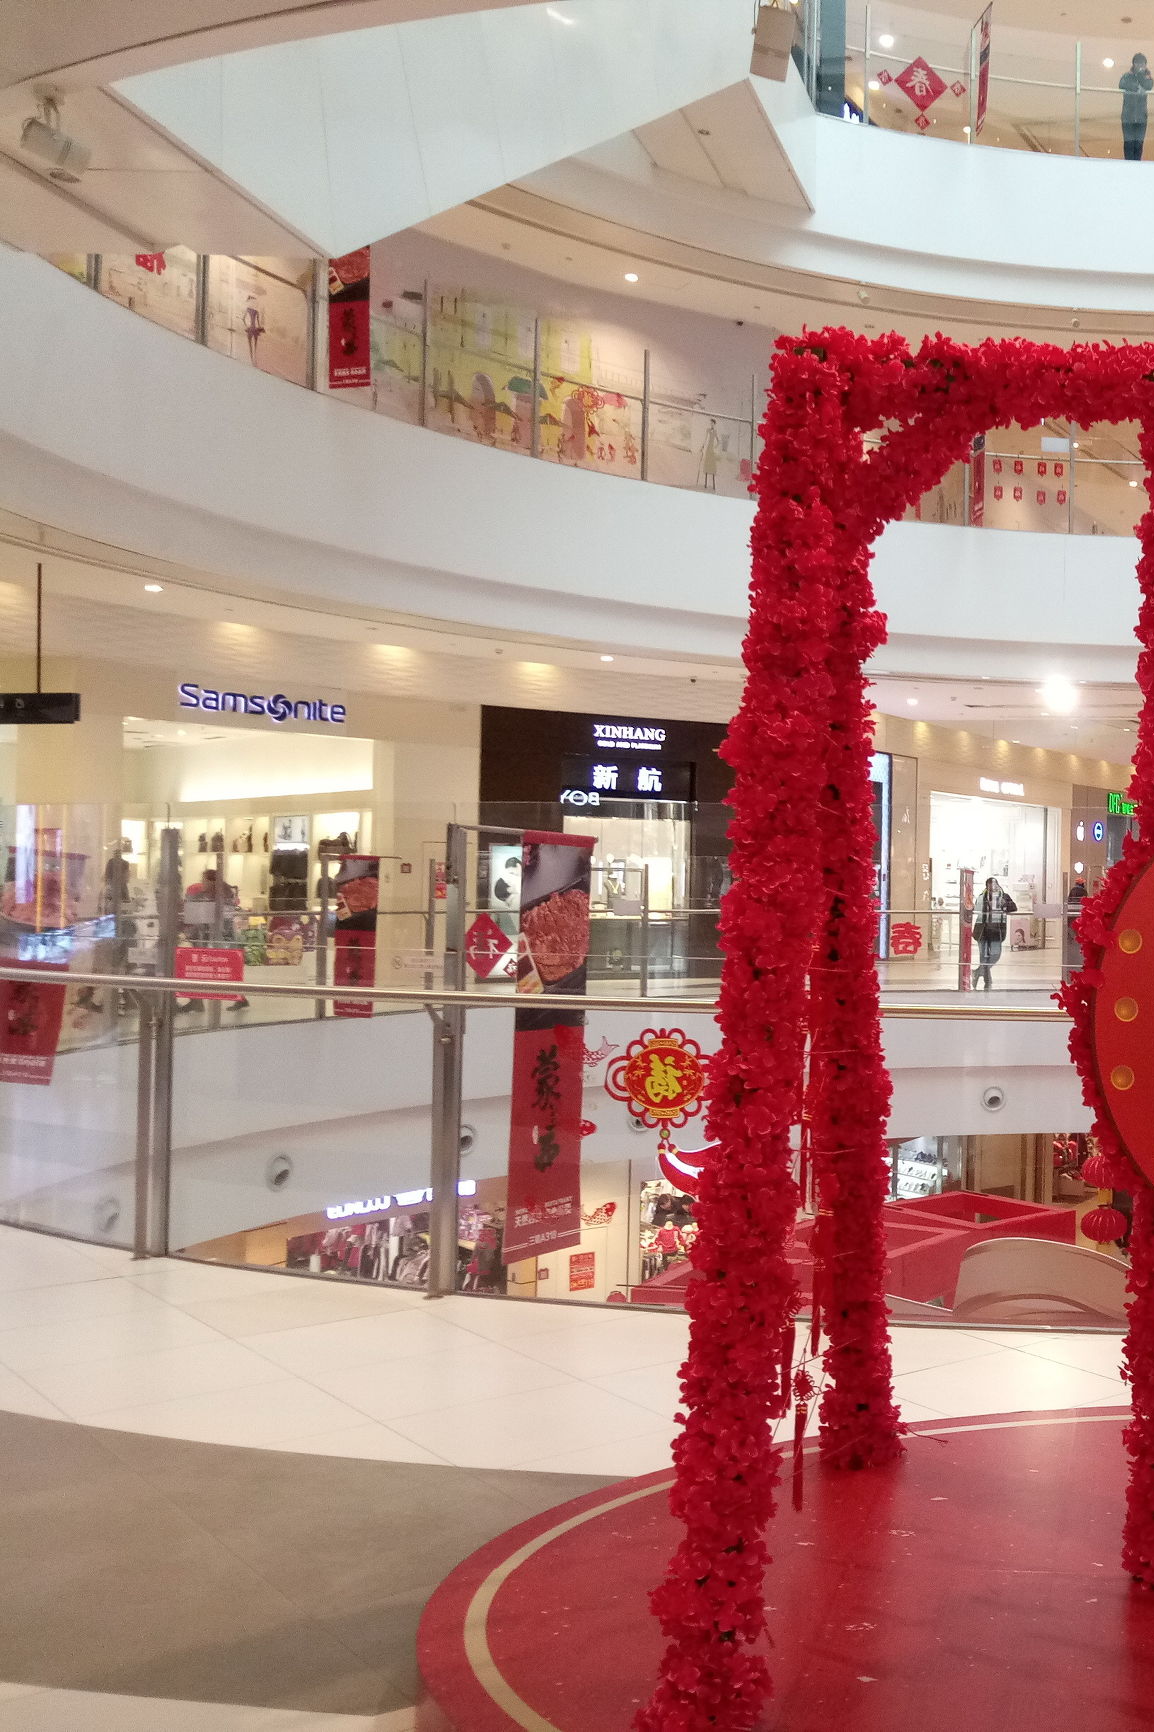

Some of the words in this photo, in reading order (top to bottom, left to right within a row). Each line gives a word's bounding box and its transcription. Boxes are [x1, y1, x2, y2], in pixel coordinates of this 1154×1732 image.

[906, 67, 934, 96] 春
[178, 681, 347, 724] Samsonite
[594, 724, 666, 742] XINHANG
[593, 764, 662, 792] 新航
